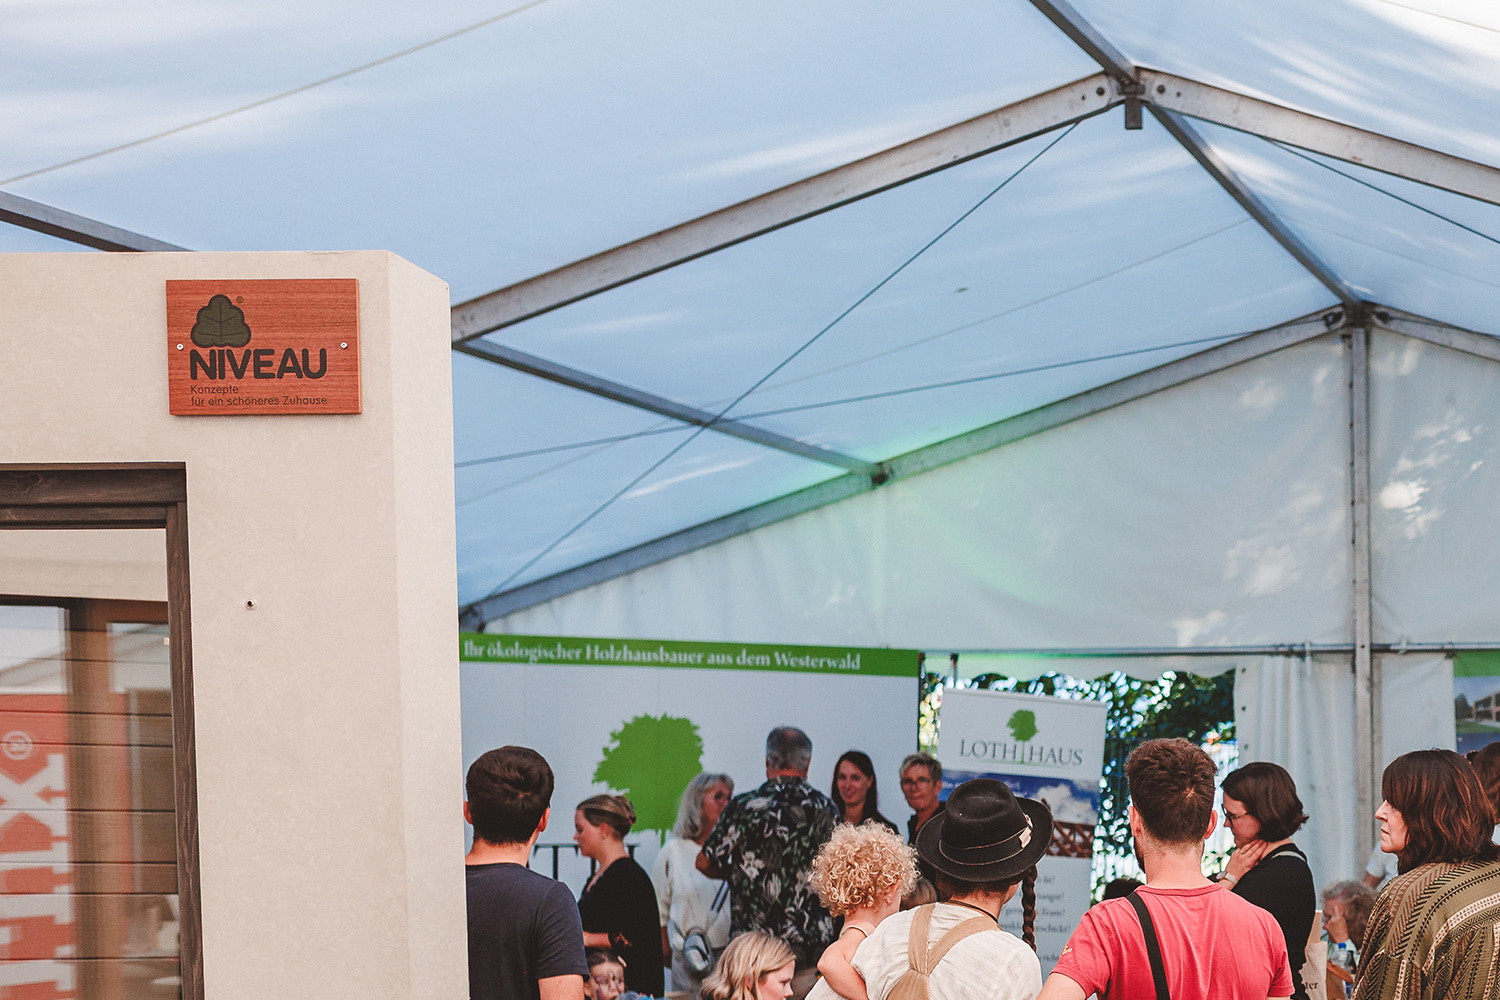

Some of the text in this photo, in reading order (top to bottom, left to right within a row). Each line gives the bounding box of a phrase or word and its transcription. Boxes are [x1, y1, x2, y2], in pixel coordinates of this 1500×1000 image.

[190, 347, 327, 380] NIVEAU
[190, 385, 239, 395] Konzepte
[191, 395, 328, 406] für ein schöneres Zuhause
[464, 639, 861, 671] Ihr ökologischer Holzhausbauer aus dem Westerwald
[959, 739, 1084, 767] LOTH HAUS
